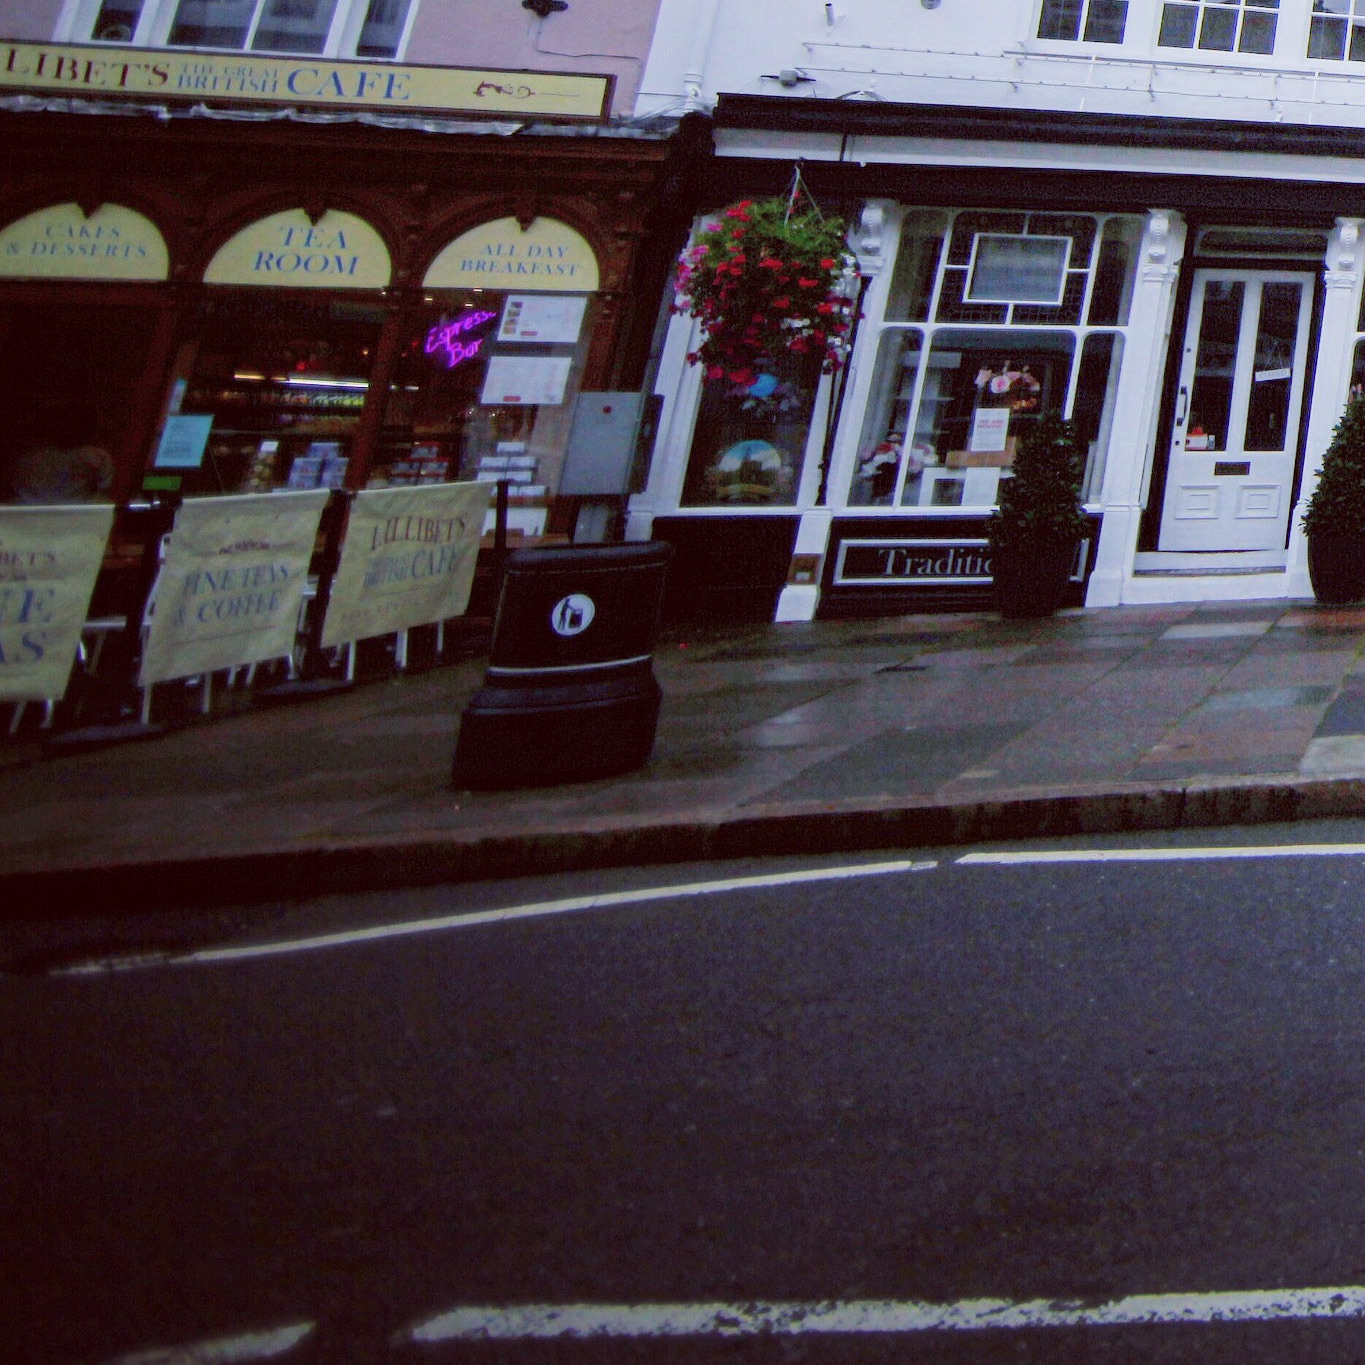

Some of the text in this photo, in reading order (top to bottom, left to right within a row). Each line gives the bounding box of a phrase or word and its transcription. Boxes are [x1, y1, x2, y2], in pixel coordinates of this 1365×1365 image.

[176, 73, 279, 94] BRITISH
[286, 67, 411, 101] CAFE
[45, 225, 122, 238] CAKES
[280, 226, 348, 250] TEA
[31, 241, 148, 259] DESSERTS
[480, 243, 570, 259] ALL DAY
[254, 251, 360, 276] ROOM
[460, 259, 581, 277] BREAKFAST
[448, 338, 484, 368] Bar
